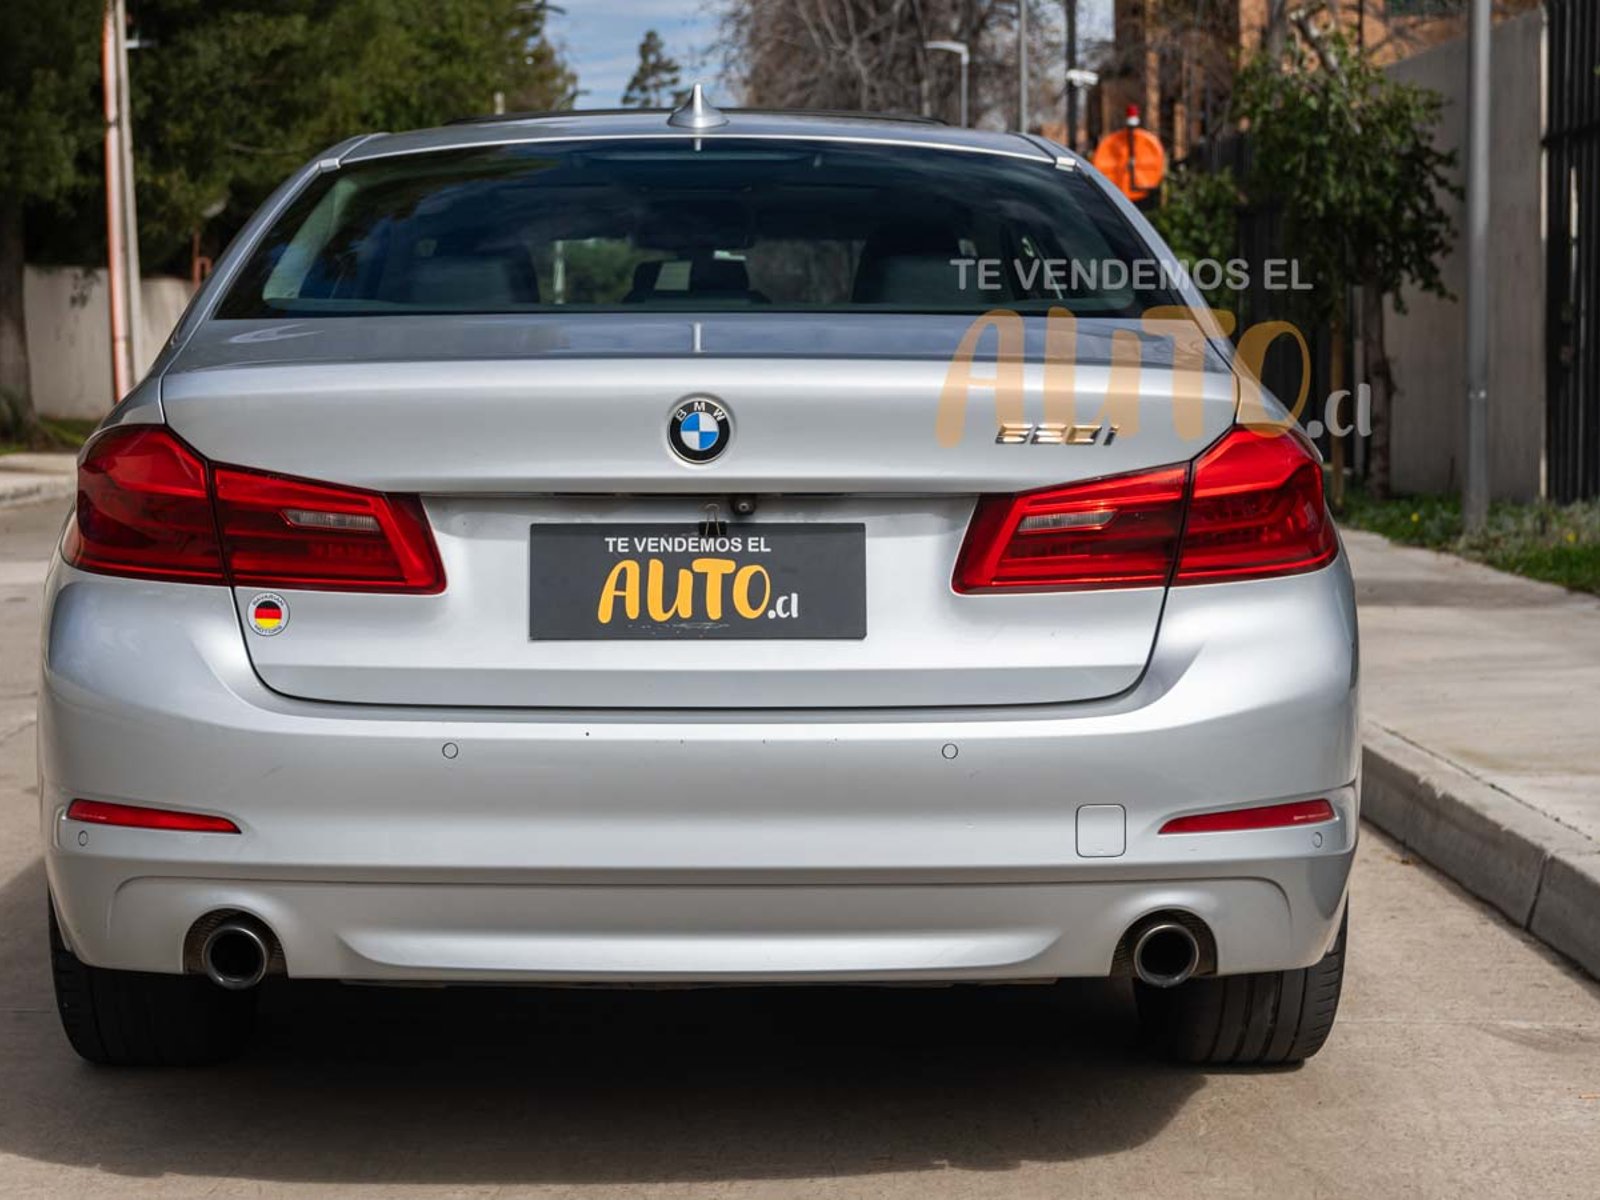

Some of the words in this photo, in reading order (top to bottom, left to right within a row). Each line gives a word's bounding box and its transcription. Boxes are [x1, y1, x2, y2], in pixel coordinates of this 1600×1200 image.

[676, 402, 726, 421] BMW
[605, 537, 629, 552] TE
[634, 537, 742, 553] VENDEMOS
[747, 537, 771, 552] EL
